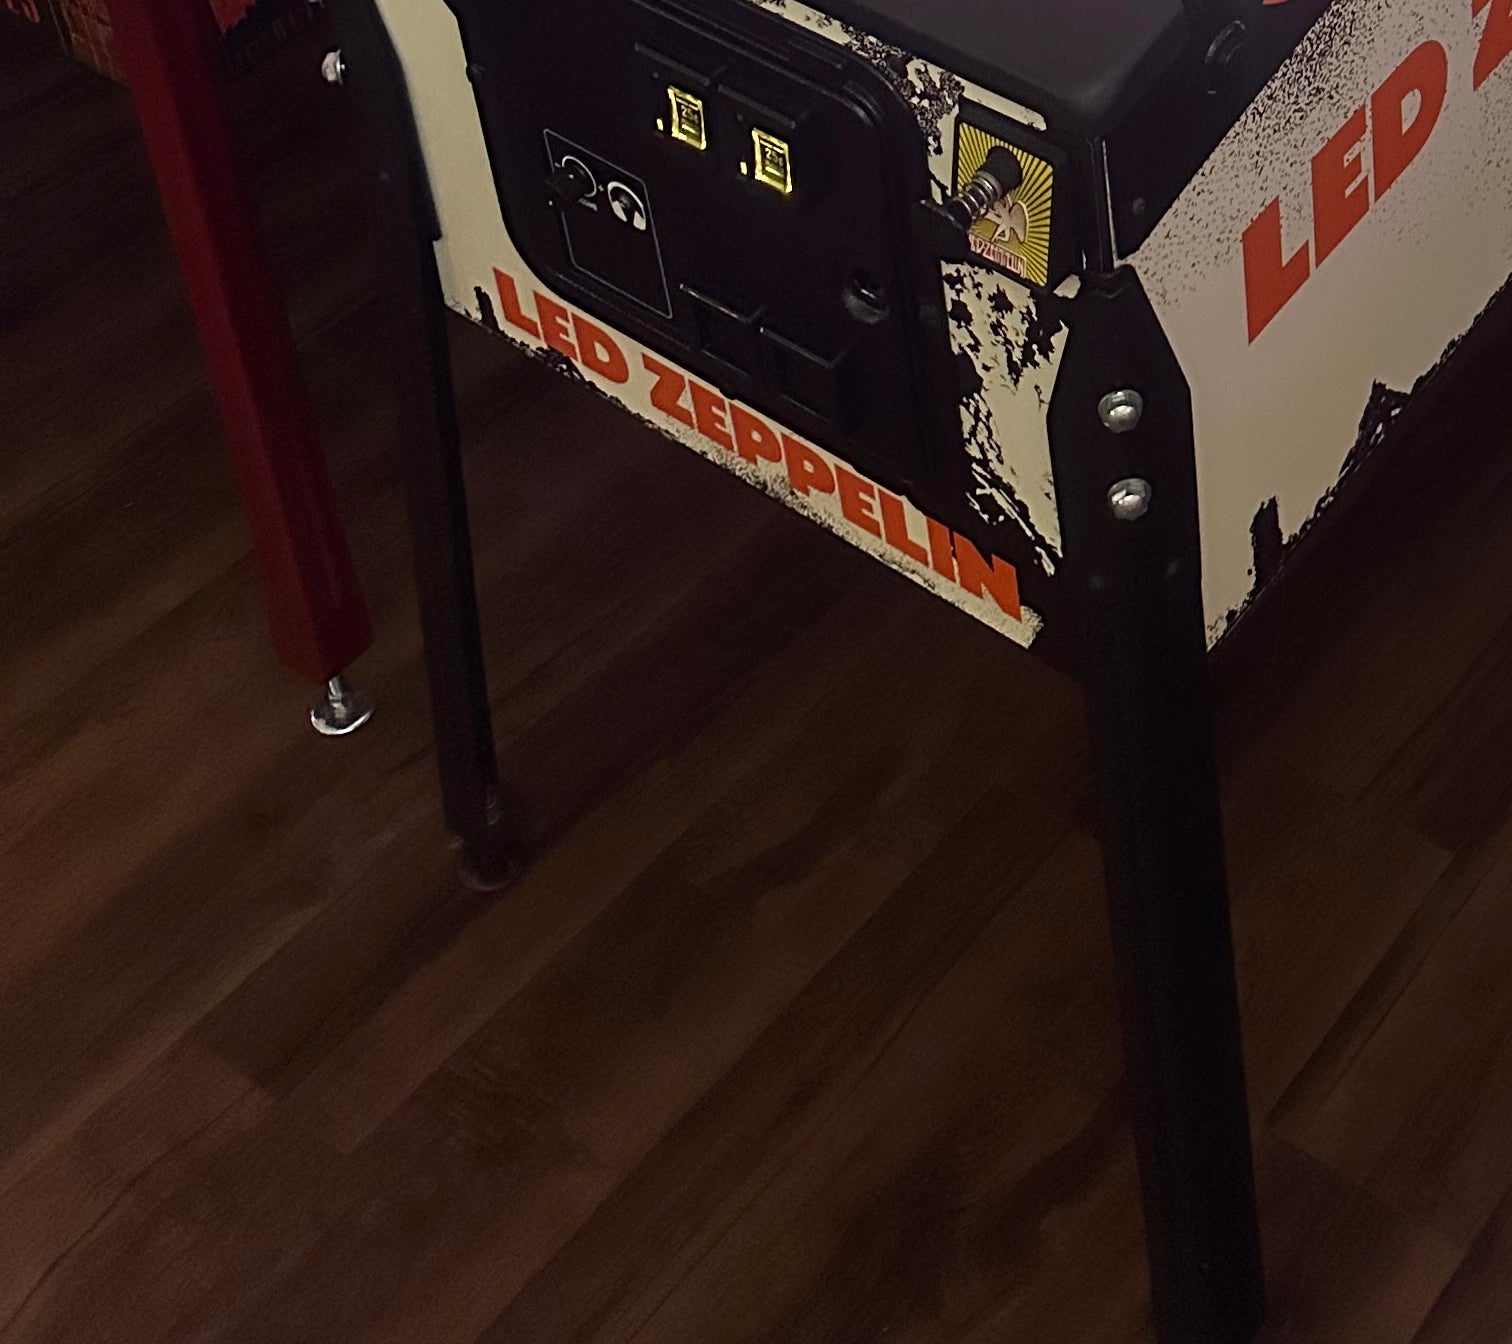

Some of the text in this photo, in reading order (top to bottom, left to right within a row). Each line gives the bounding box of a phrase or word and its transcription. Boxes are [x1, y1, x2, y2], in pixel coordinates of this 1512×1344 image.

[1241, 39, 1448, 345] LED
[493, 267, 1024, 622] LED ZEPPELIN
